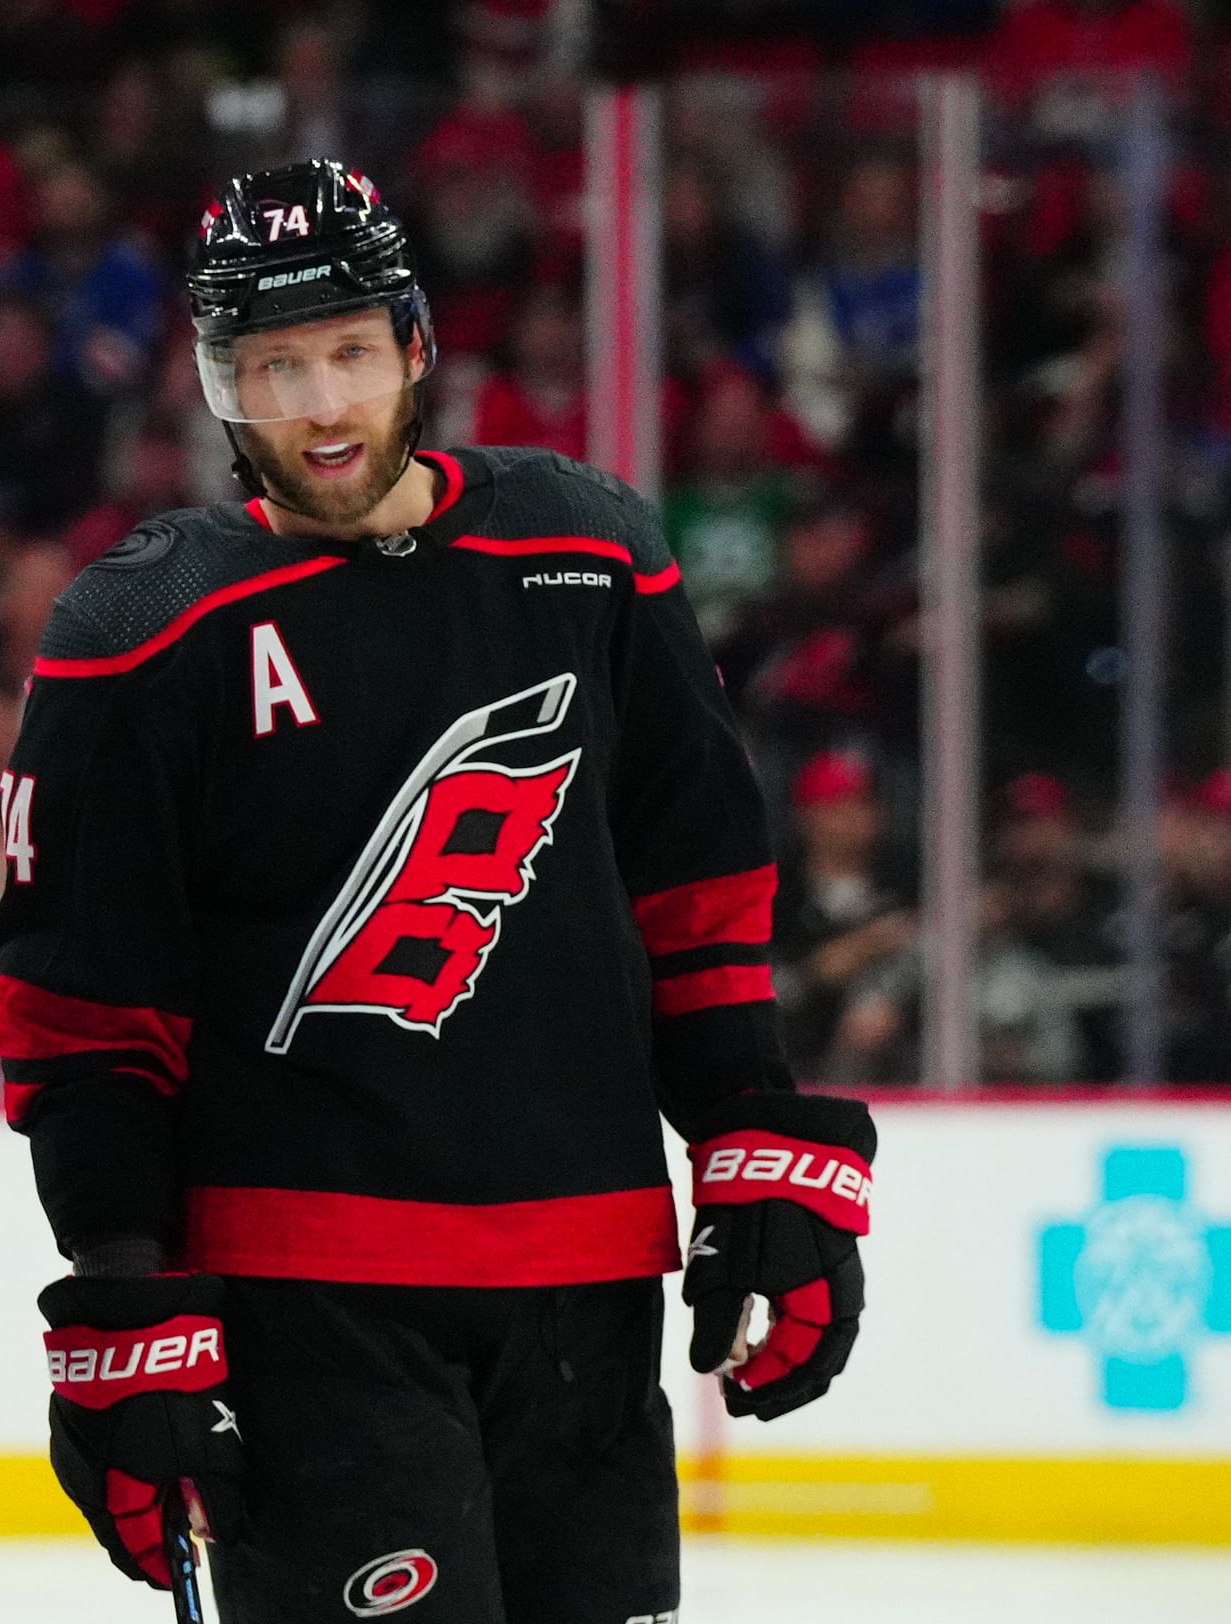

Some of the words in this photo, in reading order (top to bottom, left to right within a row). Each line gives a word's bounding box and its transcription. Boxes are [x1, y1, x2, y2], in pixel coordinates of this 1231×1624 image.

[262, 204, 311, 243] 74
[522, 571, 612, 589] NUCOR
[250, 619, 321, 739] A
